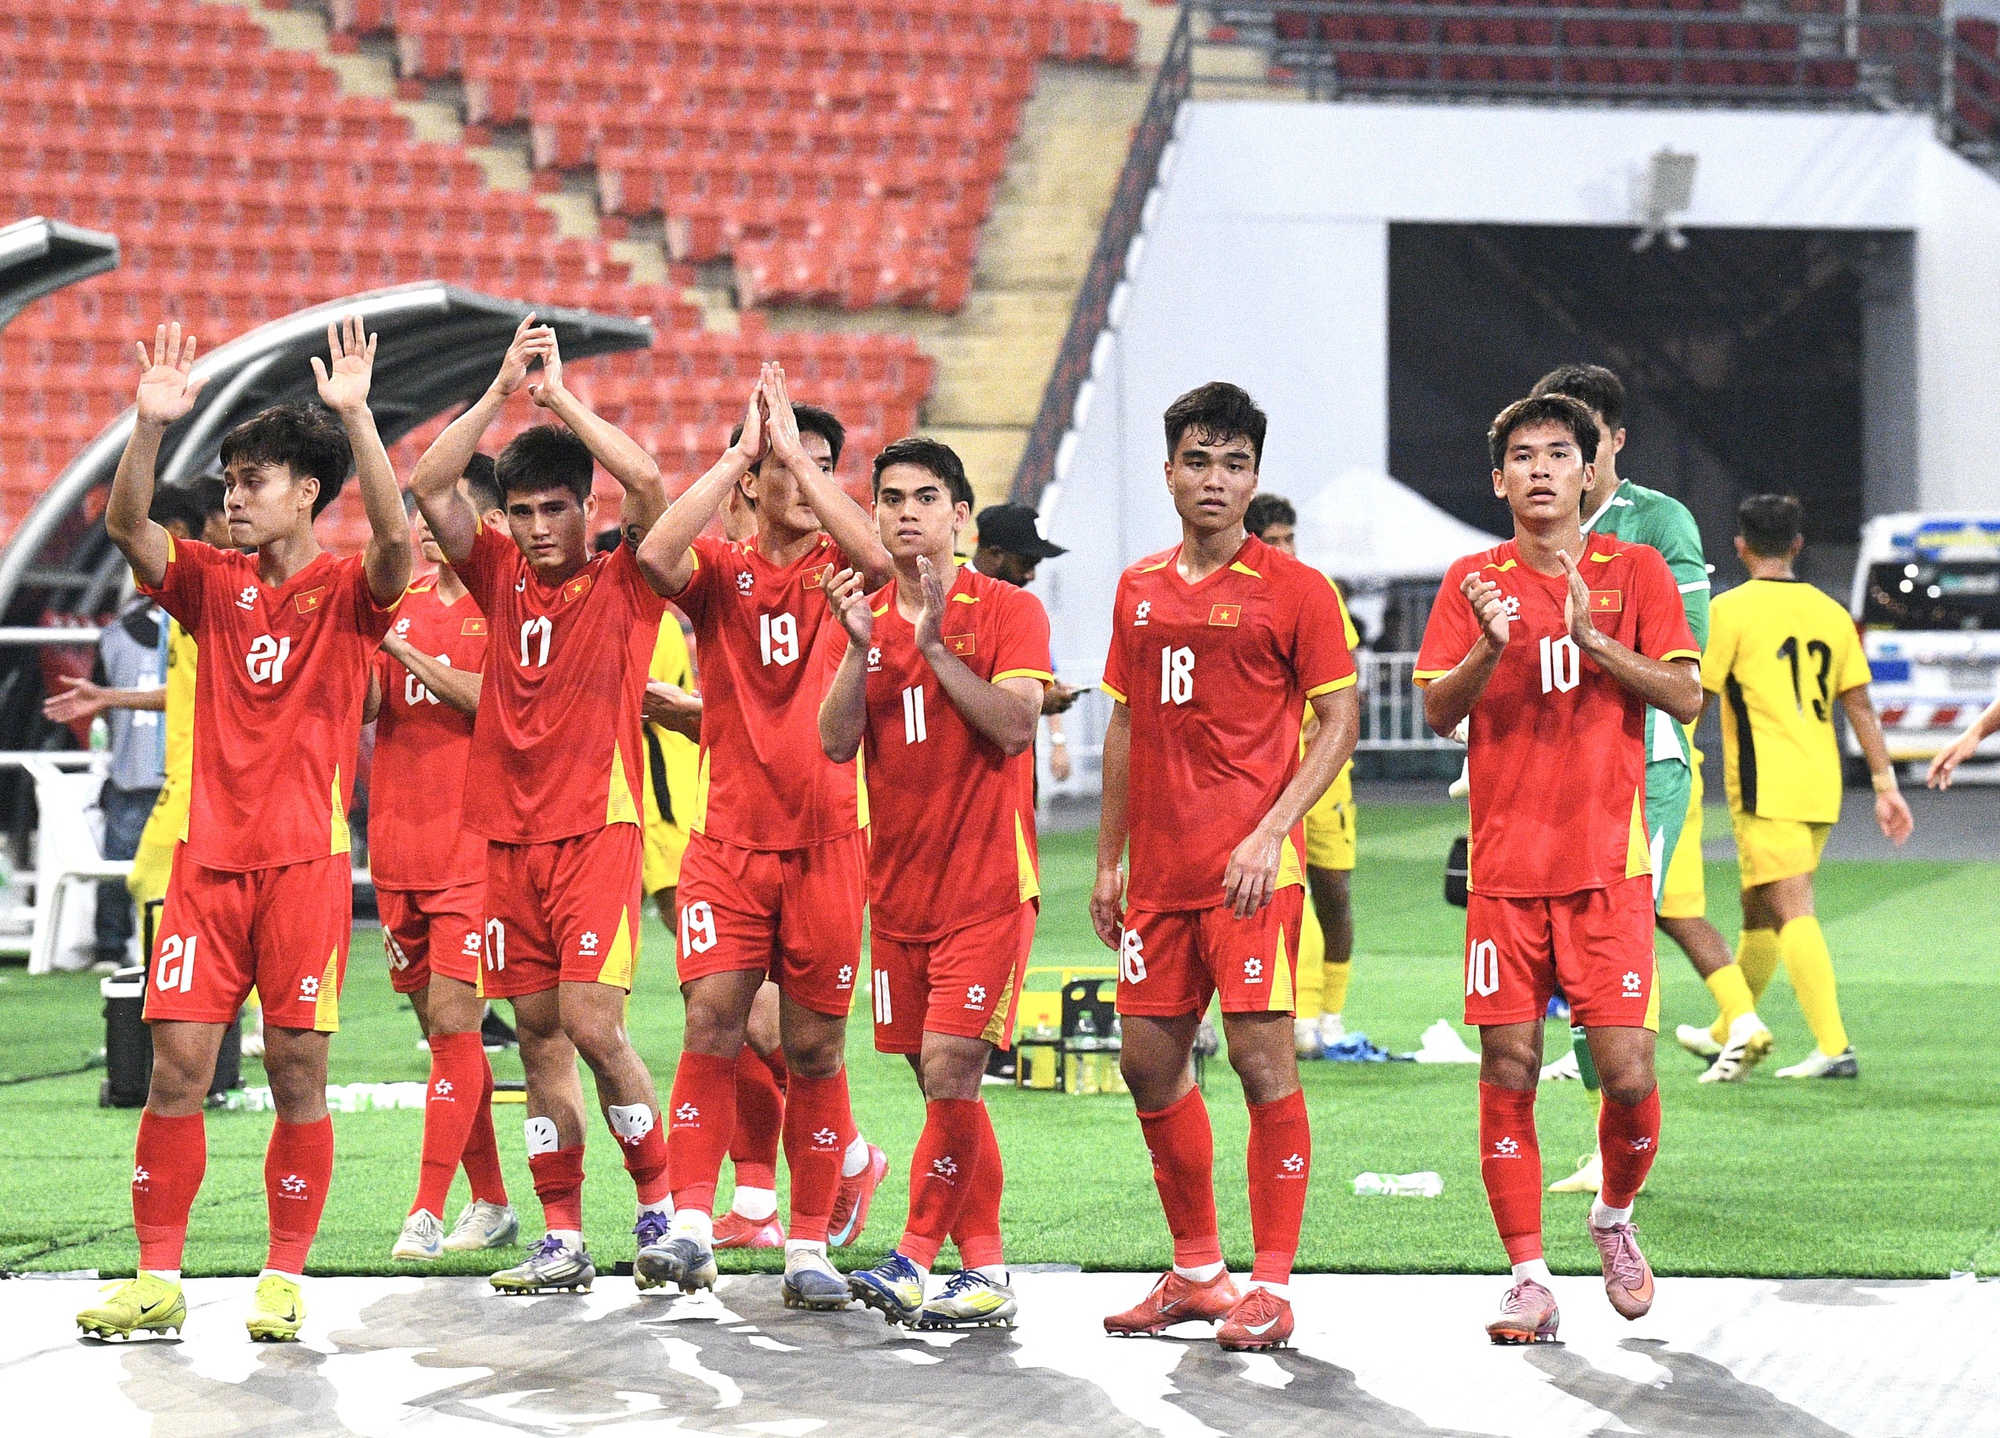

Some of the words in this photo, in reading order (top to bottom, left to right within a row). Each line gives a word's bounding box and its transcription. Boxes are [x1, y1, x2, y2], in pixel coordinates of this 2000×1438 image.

[245, 634, 291, 685] 21
[519, 615, 552, 668] 17
[759, 611, 799, 667] 19
[1539, 634, 1580, 694] 10
[1160, 645, 1195, 706] 18
[1777, 636, 1831, 723] 13
[902, 685, 927, 745] 11
[484, 917, 505, 971] 17
[681, 900, 718, 960] 19
[1119, 926, 1148, 985] 18
[155, 933, 198, 994] 21
[1466, 938, 1500, 997] 10
[874, 968, 893, 1026] 11
